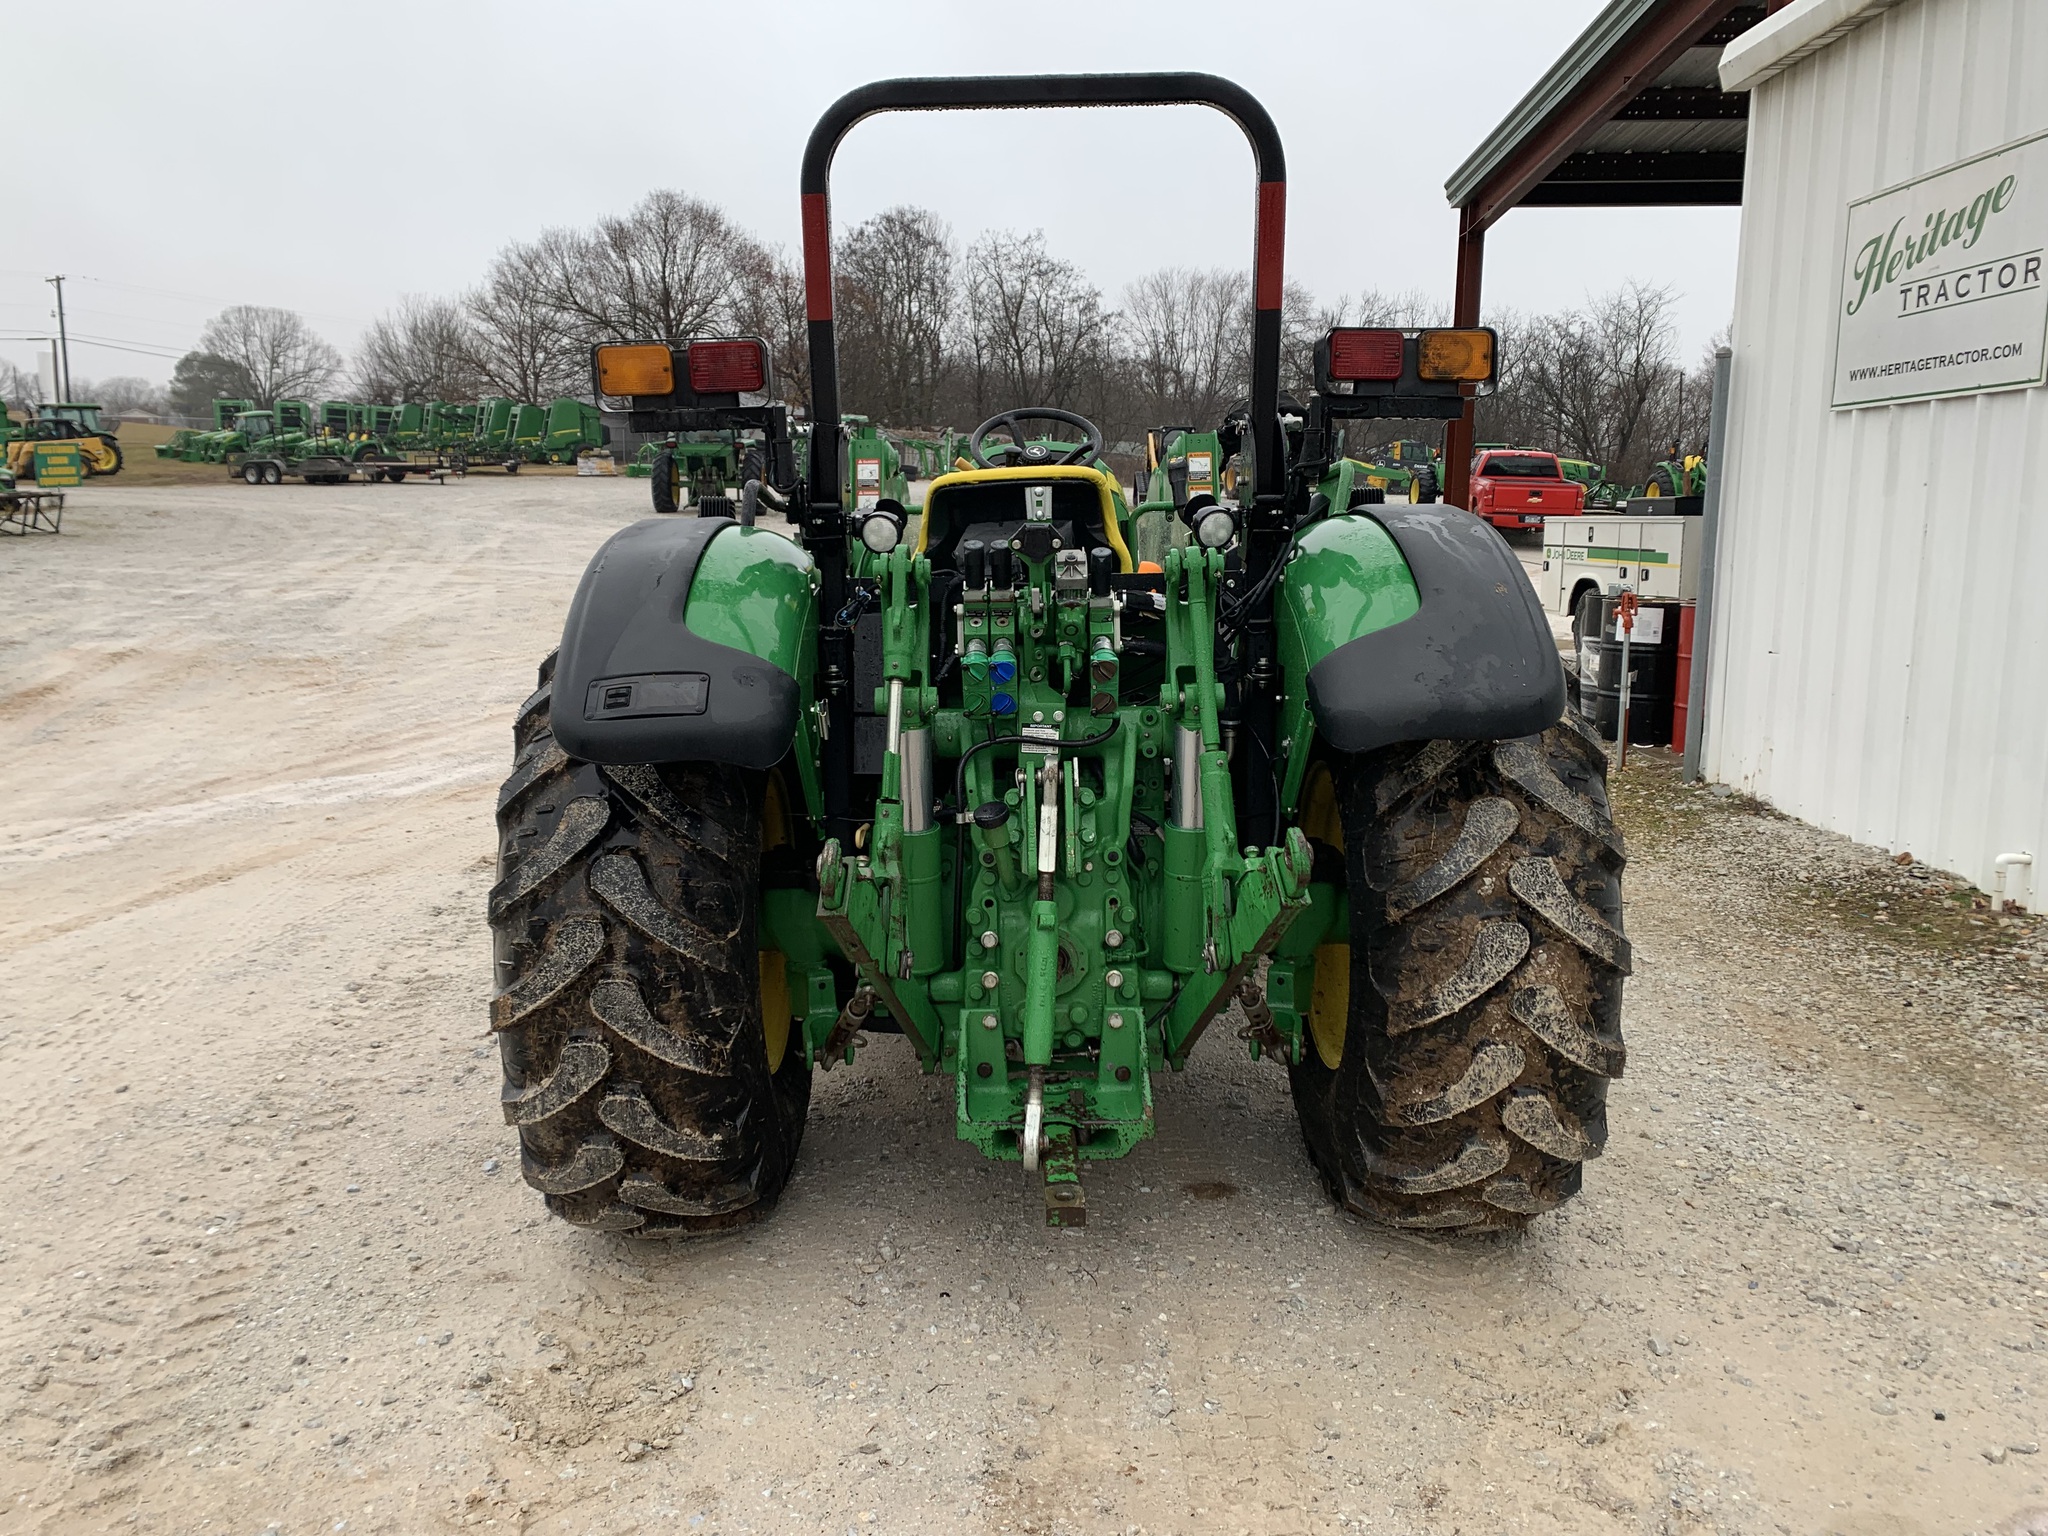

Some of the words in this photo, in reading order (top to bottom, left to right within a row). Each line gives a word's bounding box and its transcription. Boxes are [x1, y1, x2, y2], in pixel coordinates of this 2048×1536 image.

[1847, 174, 2018, 315] Heritage
[1900, 256, 2042, 312] TRACTOR
[1849, 343, 2023, 382] WWW.HERITAGETRACTOR.COM
[1566, 548, 1585, 561] DEERE
